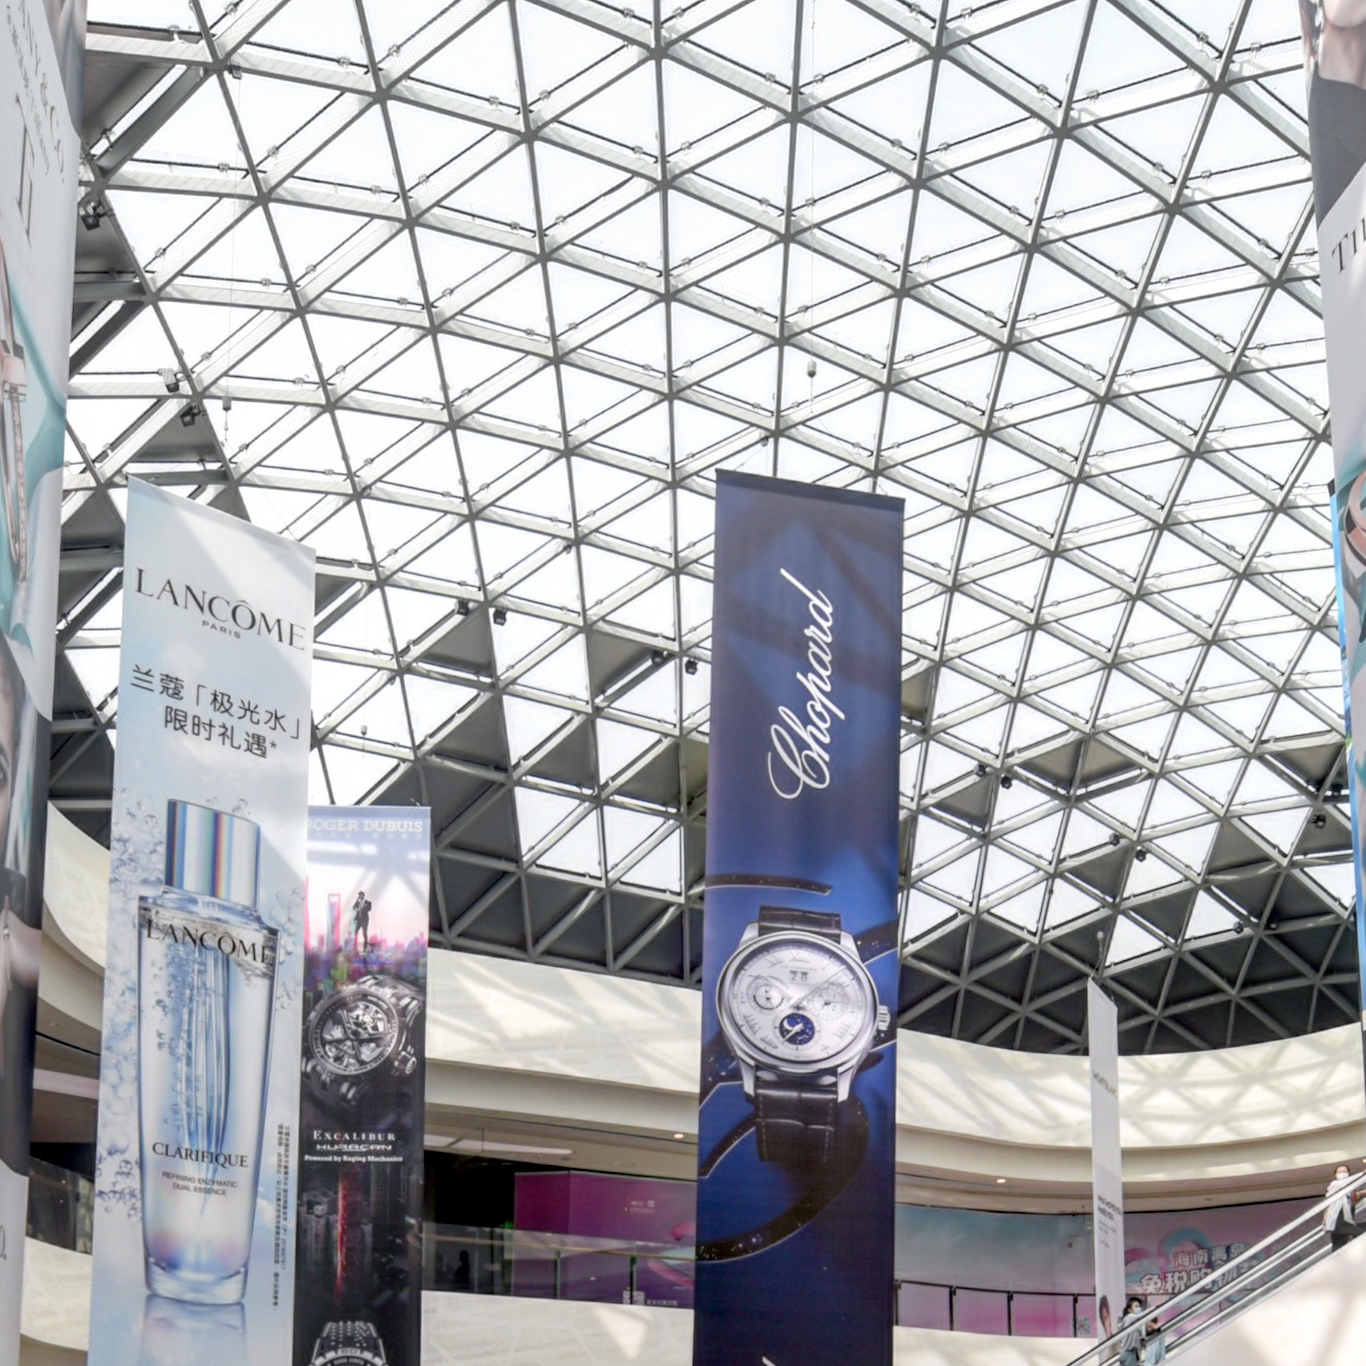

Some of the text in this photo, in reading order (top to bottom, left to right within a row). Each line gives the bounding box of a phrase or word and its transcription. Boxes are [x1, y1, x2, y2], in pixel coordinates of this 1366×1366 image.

[135, 567, 306, 651] LANCÔME
[202, 618, 242, 640] PARIS
[767, 567, 846, 800] Chopard
[364, 820, 423, 833] DUBUIS
[313, 1130, 396, 1141] EXCALIBUR
[152, 1142, 249, 1169] CLARIFIQUE
[304, 1154, 333, 1162] Powered
[162, 1171, 239, 1189] REFINING ENZYMATIC
[172, 1182, 227, 1196] DUAL ESSENCE
